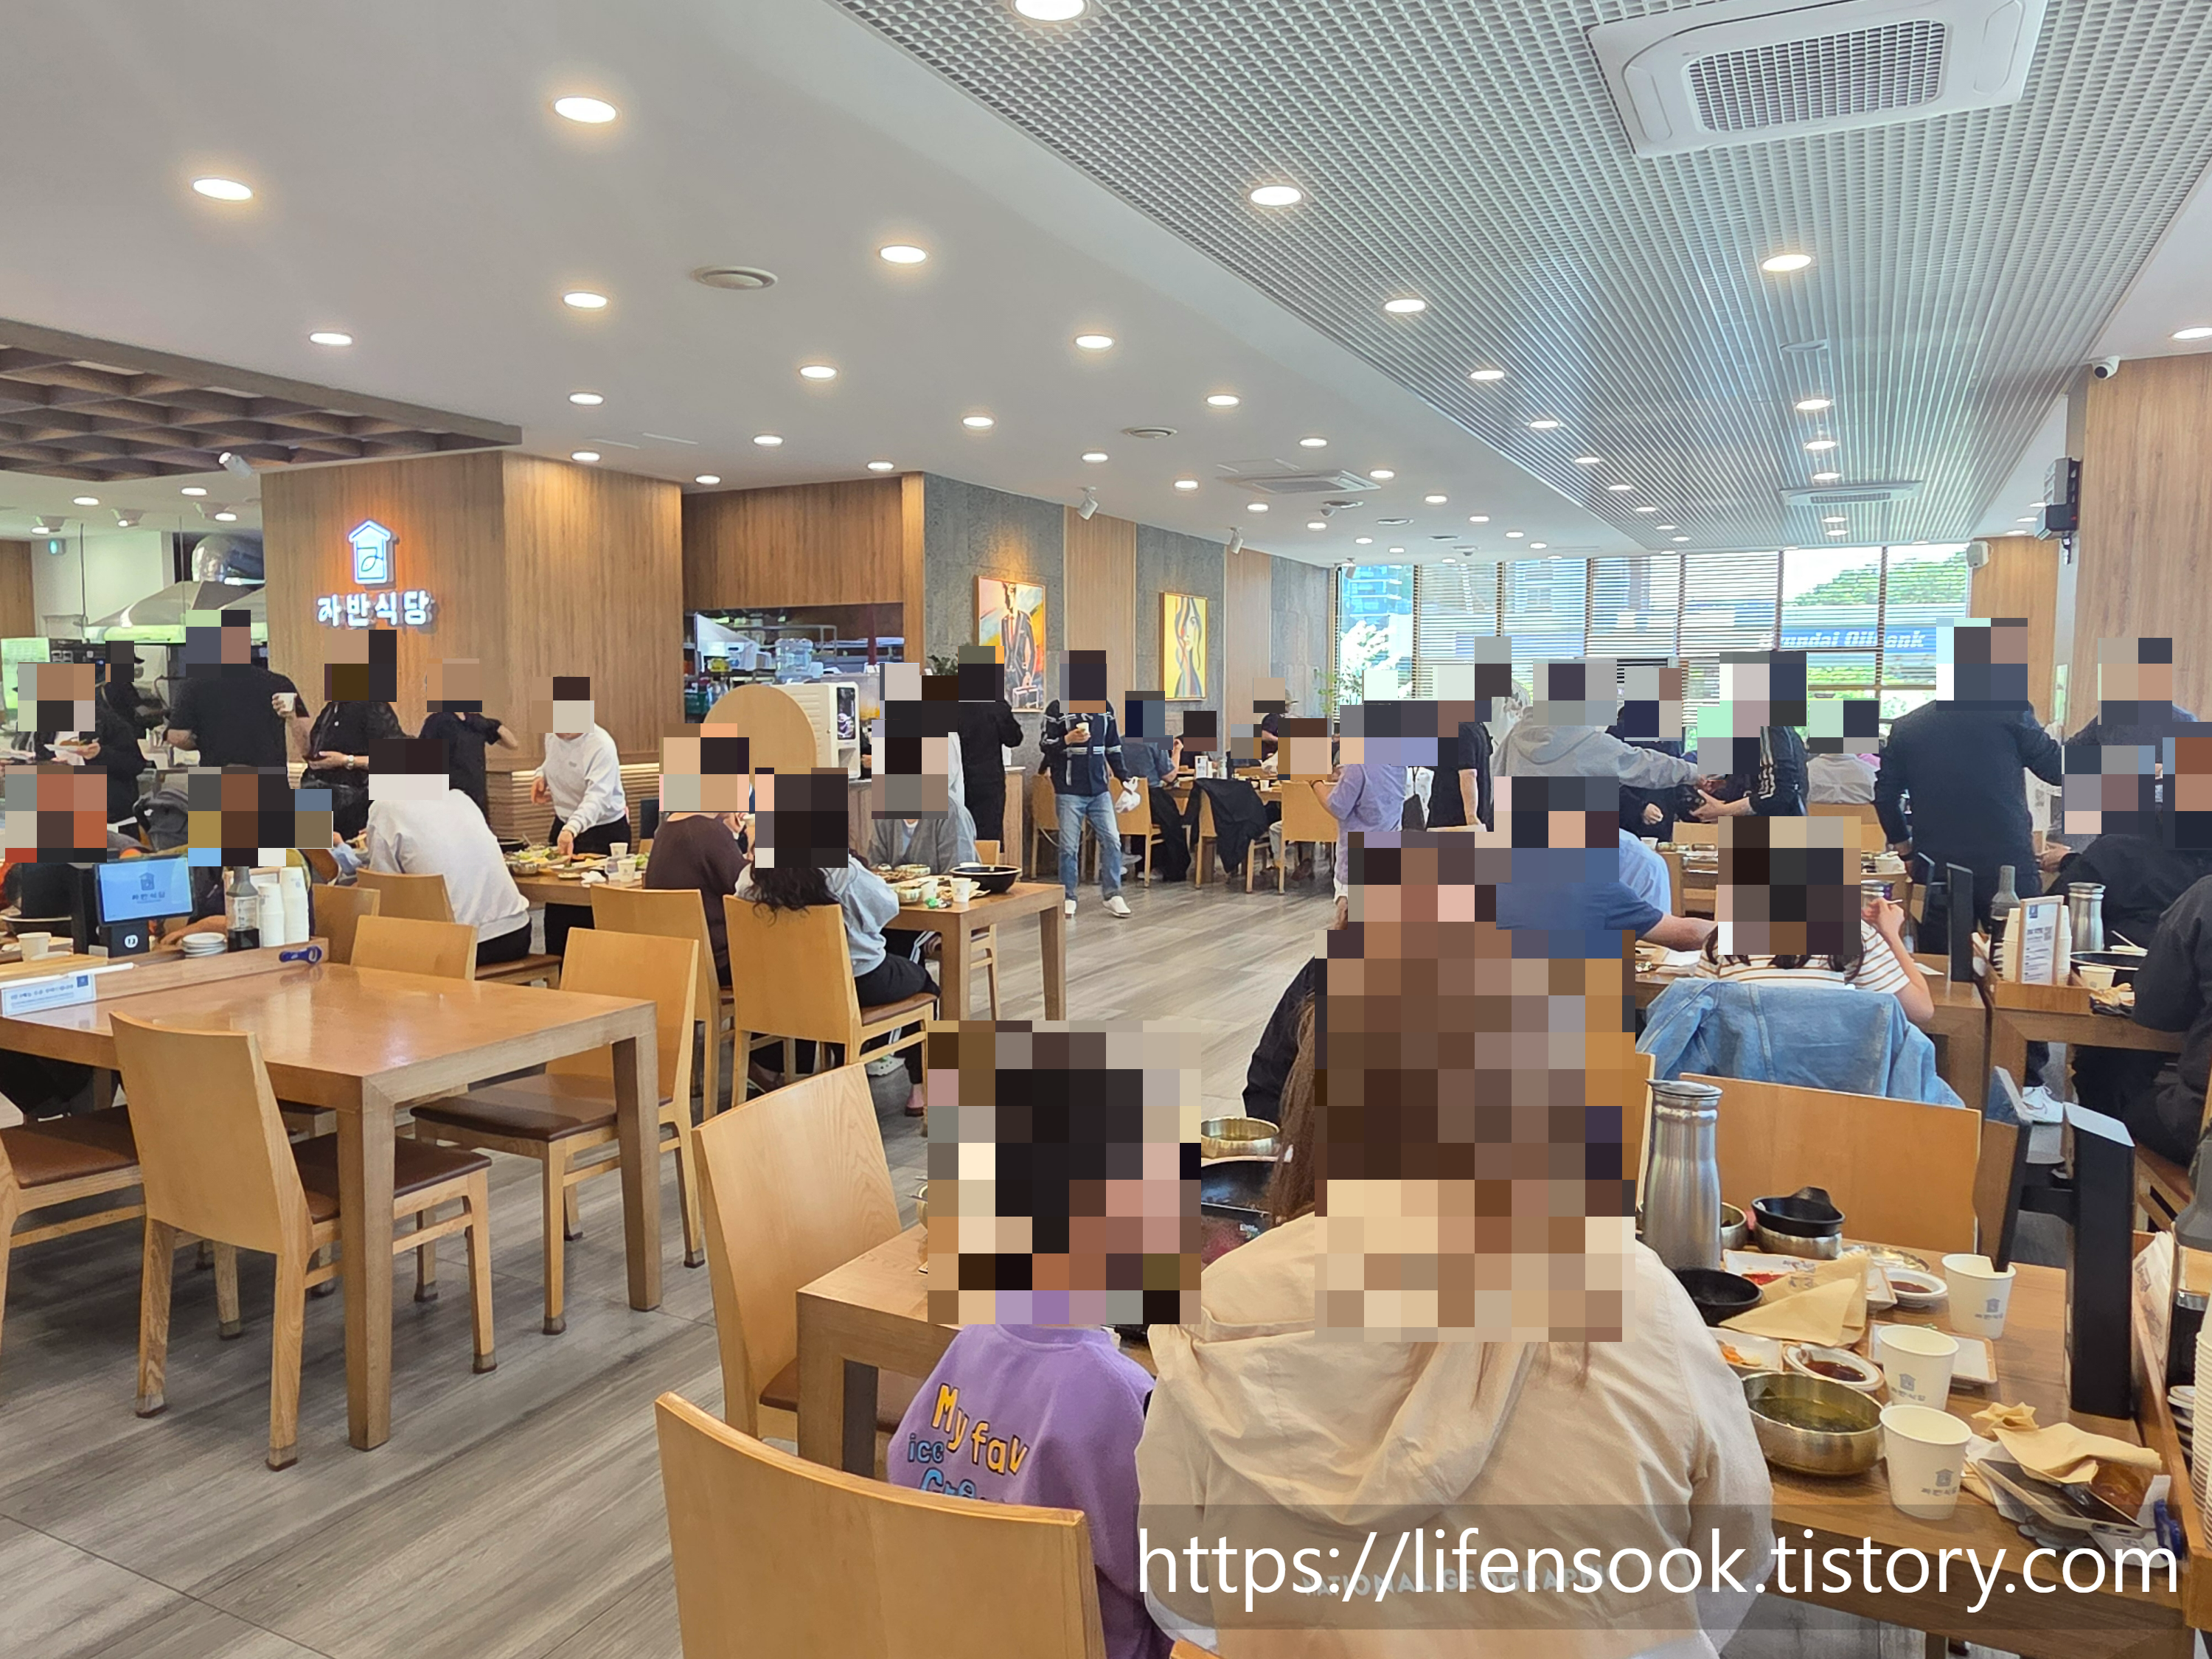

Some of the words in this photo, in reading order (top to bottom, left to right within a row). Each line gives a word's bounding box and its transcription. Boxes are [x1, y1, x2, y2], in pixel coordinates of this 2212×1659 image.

[318, 591, 430, 627] 자반식당
[931, 1382, 970, 1453] My
[971, 1420, 1030, 1475] fav
[908, 1433, 945, 1463] ice
